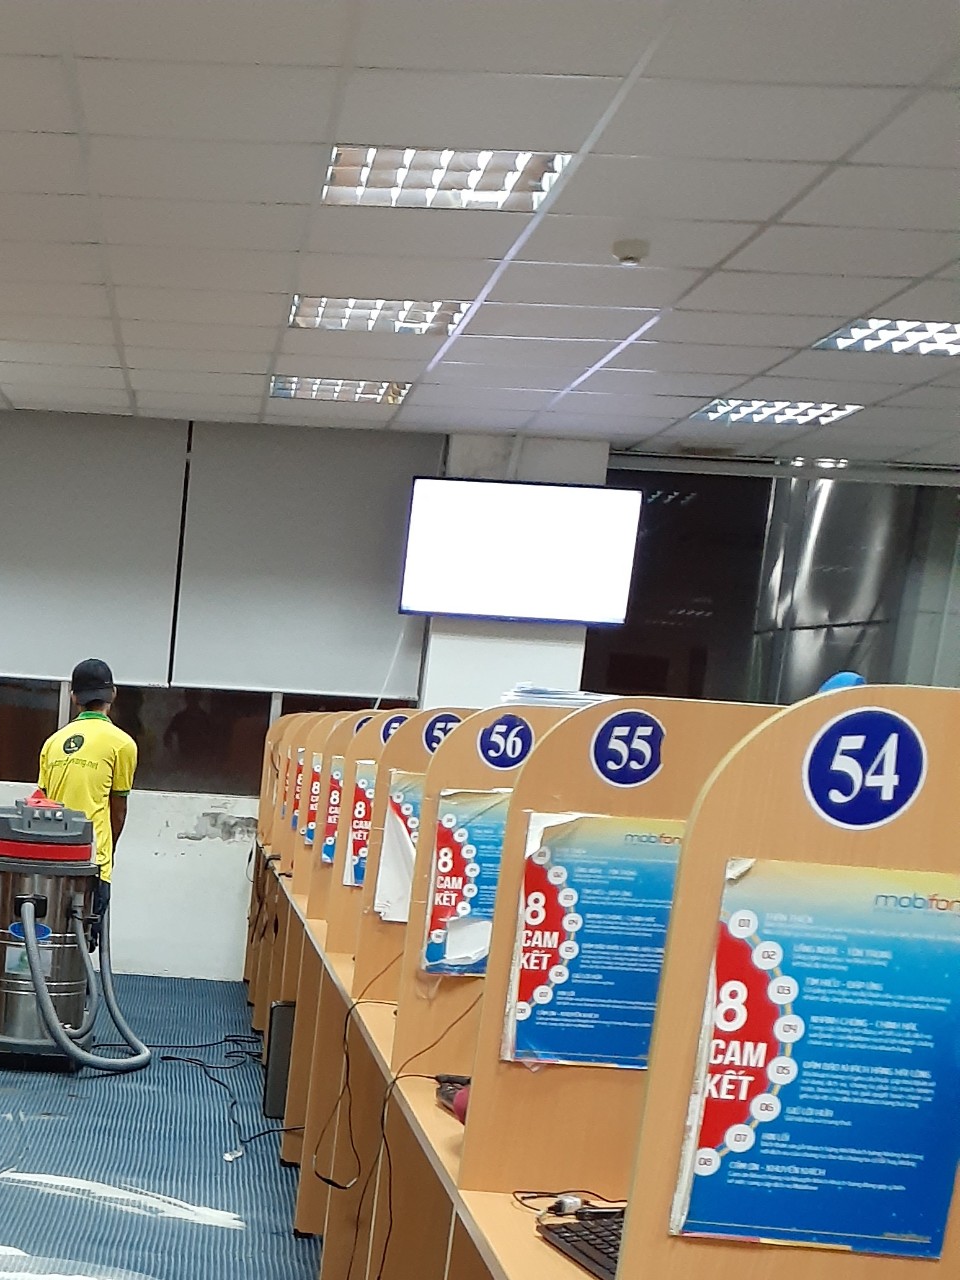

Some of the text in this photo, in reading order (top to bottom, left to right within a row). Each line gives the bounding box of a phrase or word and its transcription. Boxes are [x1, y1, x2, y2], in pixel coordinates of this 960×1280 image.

[487, 724, 523, 759] 56
[607, 726, 653, 770] 55
[828, 733, 899, 803] 54
[329, 789, 340, 805] 8
[353, 801, 366, 819] 8
[437, 847, 454, 873] 8
[436, 875, 463, 890] CAM
[525, 891, 547, 926] 8
[522, 929, 559, 949] CAM
[519, 950, 552, 971] KẾT
[761, 950, 777, 960] 02
[714, 980, 748, 1032] 8
[783, 1023, 797, 1034] 04
[708, 1039, 768, 1068] CAM
[776, 1065, 790, 1075] 05
[703, 1070, 755, 1101] KẾT
[760, 1102, 774, 1112] 06
[733, 1133, 748, 1143] 07
